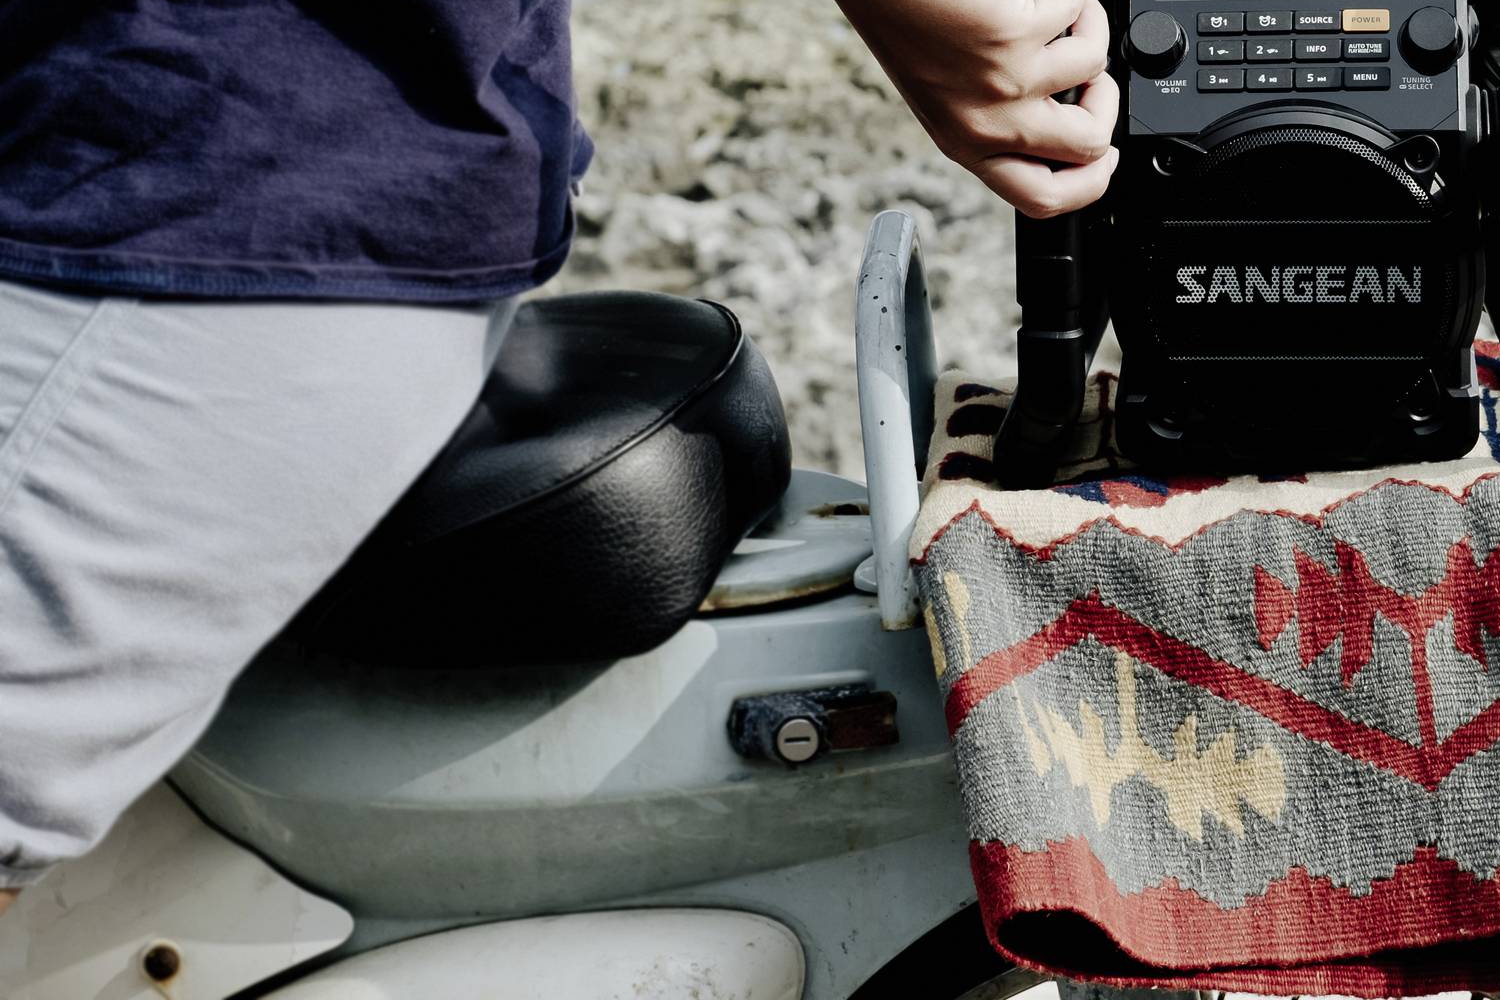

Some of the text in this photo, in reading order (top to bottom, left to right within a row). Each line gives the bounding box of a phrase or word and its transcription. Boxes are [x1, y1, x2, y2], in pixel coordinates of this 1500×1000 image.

[1299, 16, 1333, 24] SOURCE
[1351, 16, 1381, 24] POWER
[1208, 46, 1215, 55] 1
[1256, 45, 1264, 55] 2
[1306, 45, 1327, 53] INFO
[1209, 75, 1217, 84] 3
[1258, 74, 1266, 83] 4
[1307, 73, 1314, 82] 5
[1353, 73, 1378, 81] MENU
[1154, 79, 1187, 87] VOLUME
[1176, 265, 1422, 303] SANGEAN
